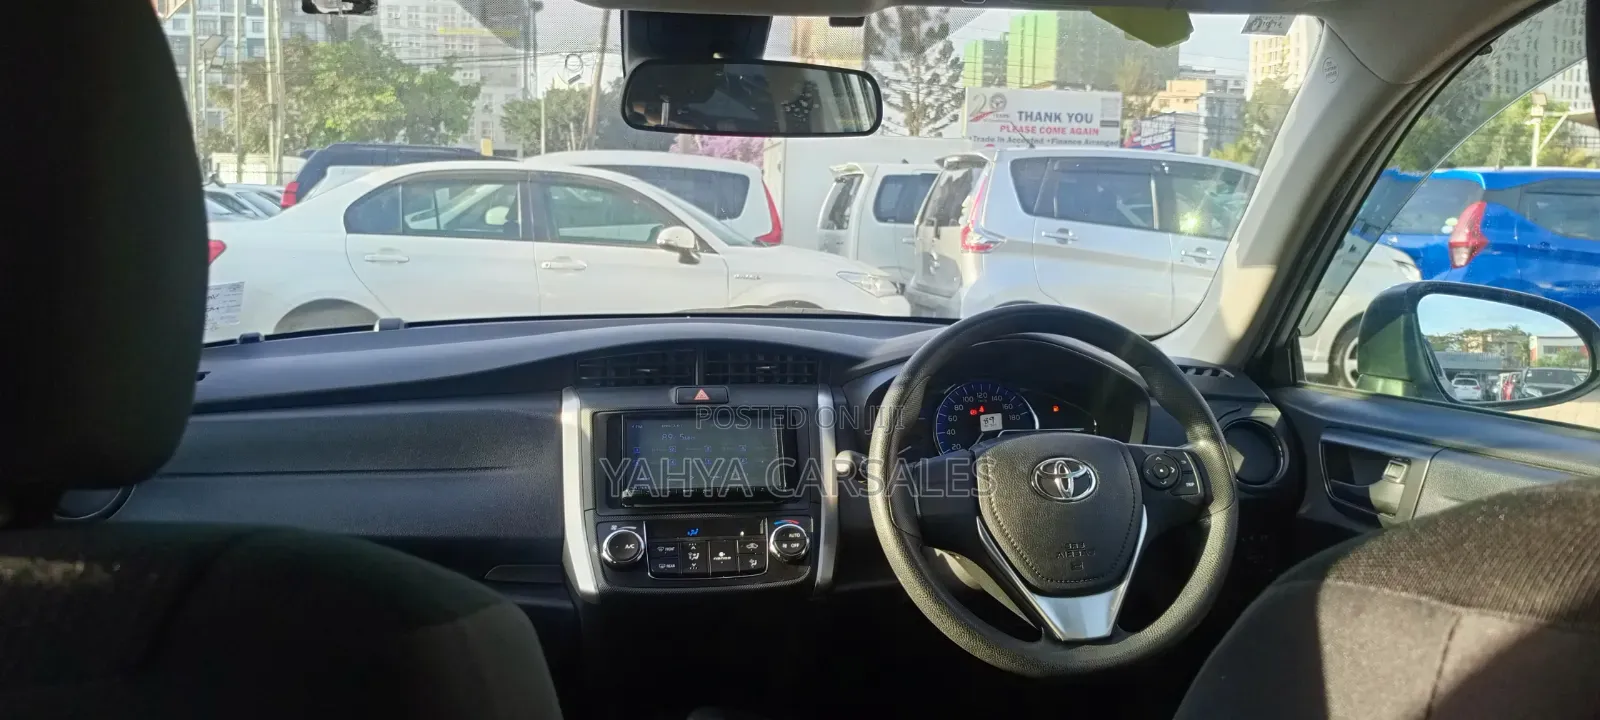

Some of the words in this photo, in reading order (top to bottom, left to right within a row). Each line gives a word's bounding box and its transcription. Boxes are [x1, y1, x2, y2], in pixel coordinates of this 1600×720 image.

[1017, 111, 1062, 123] THANK
[1067, 112, 1094, 124] YOU
[1000, 125, 1037, 134] PLEASE
[1039, 126, 1067, 135] COME
[1069, 127, 1100, 136] AGAIN
[948, 414, 958, 422] 60
[946, 428, 956, 436] 40
[951, 443, 961, 451] 20
